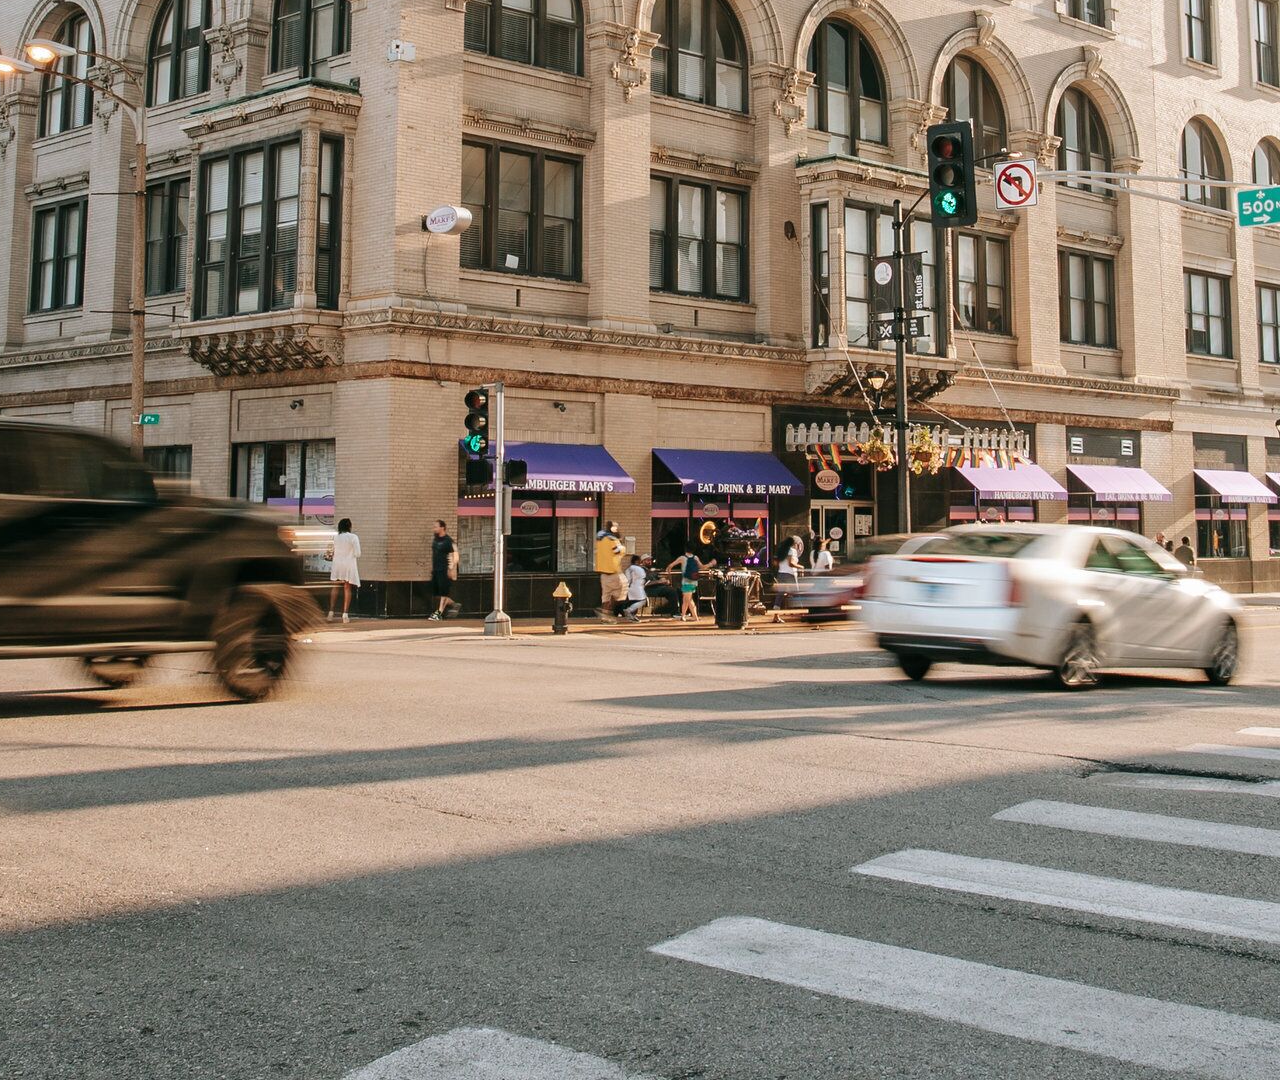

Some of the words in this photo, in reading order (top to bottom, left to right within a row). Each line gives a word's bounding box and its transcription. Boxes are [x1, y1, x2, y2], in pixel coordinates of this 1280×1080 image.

[914, 274, 923, 297] louis
[514, 479, 576, 491] AMBURGER
[579, 481, 614, 491] MARY'S
[697, 483, 715, 494] EAT,
[718, 484, 744, 494] DRINK
[746, 484, 753, 493] &
[756, 484, 766, 494] BE
[768, 485, 791, 494] MARY
